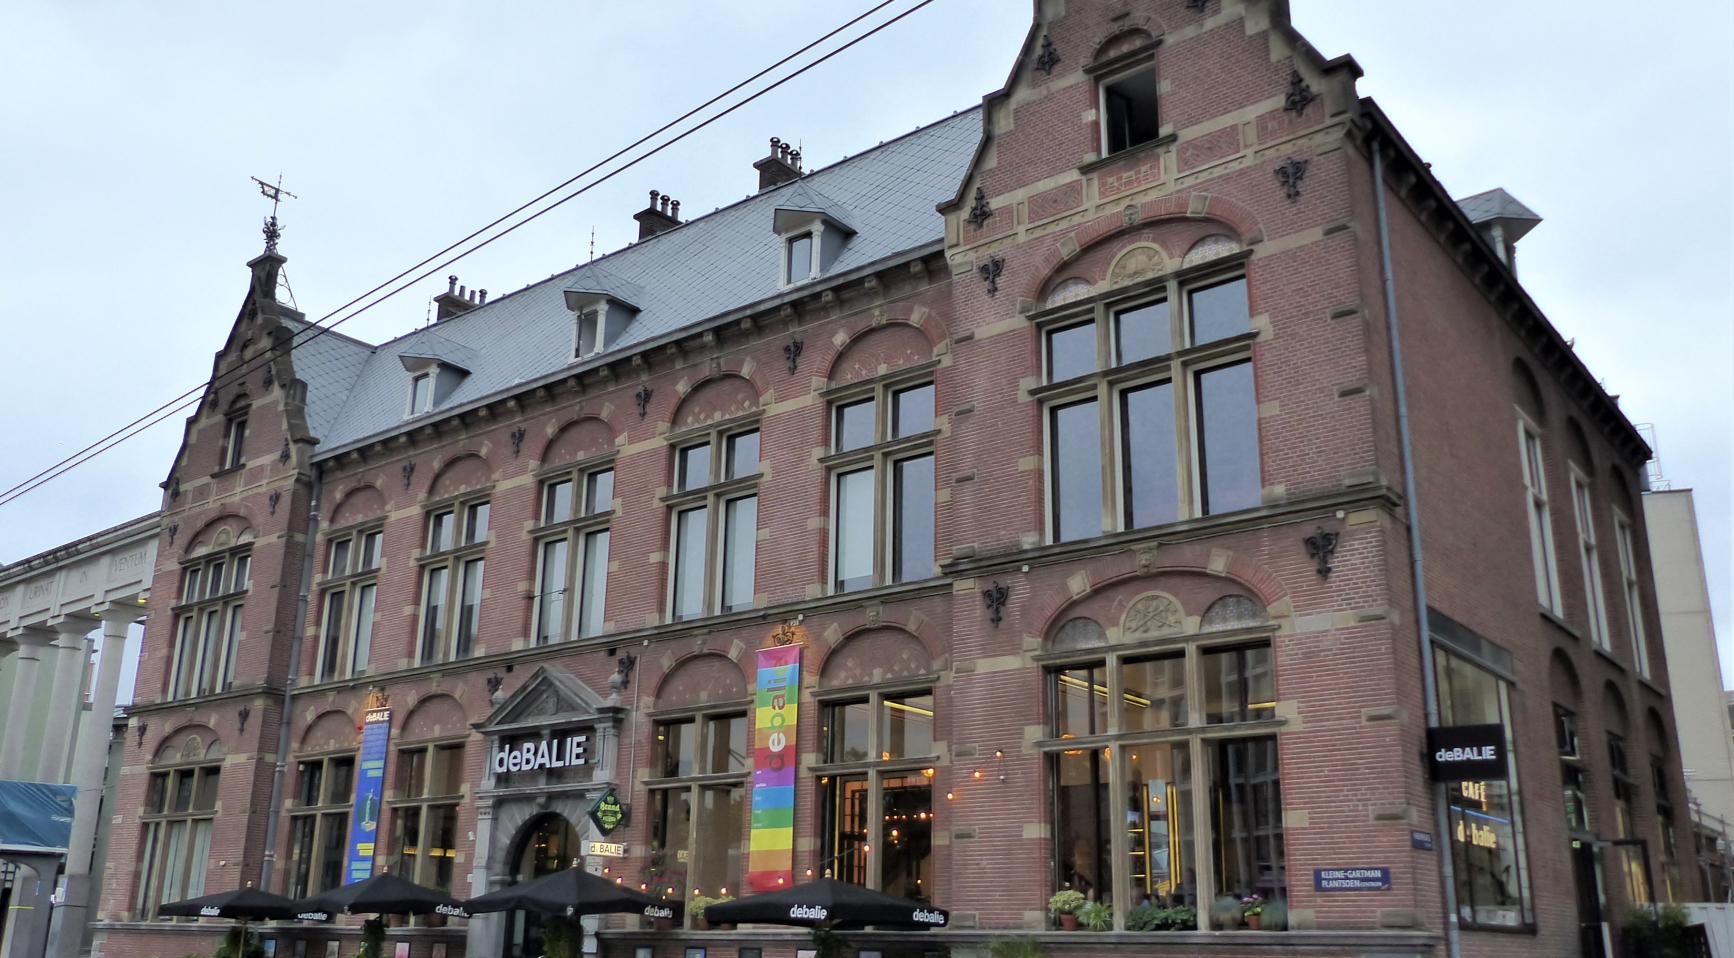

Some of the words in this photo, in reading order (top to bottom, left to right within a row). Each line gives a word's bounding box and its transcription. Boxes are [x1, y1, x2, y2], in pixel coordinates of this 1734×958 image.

[495, 735, 587, 773] deBALIE
[1435, 745, 1497, 762] deBALIE
[599, 843, 622, 856] BALIE
[1321, 869, 1382, 879] KLEINE-GARTMAN
[1321, 879, 1360, 888] PLANTSOEN
[790, 903, 828, 919] debalie
[912, 908, 945, 924] debalie
